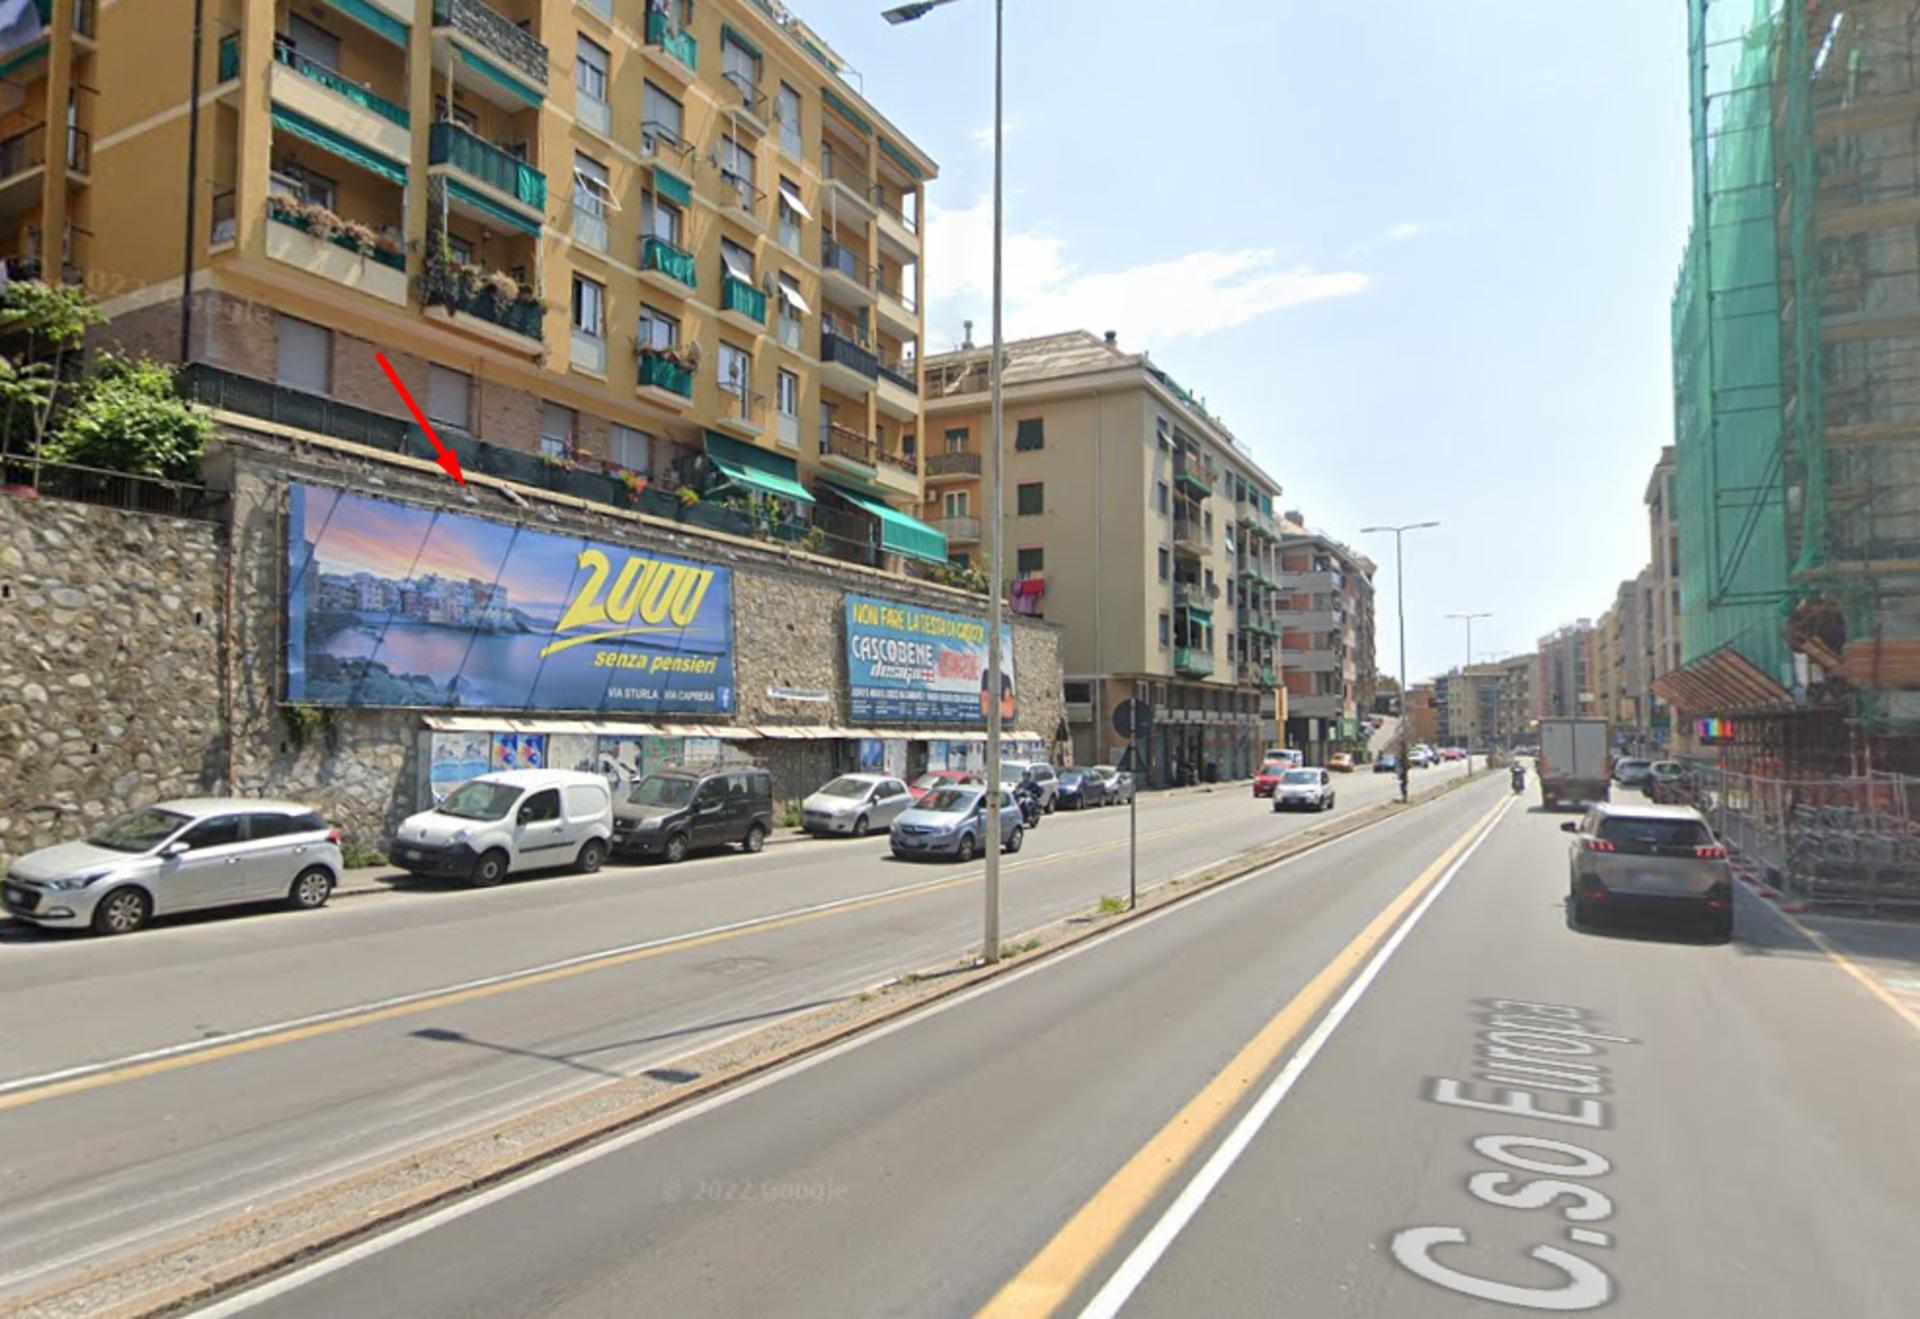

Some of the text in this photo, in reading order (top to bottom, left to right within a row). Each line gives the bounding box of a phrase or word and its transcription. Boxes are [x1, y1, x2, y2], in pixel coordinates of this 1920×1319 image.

[555, 549, 715, 632] 2000
[852, 635, 933, 666] CASCOBENE
[650, 656, 717, 673] pensieri
[624, 688, 659, 700] STURLA
